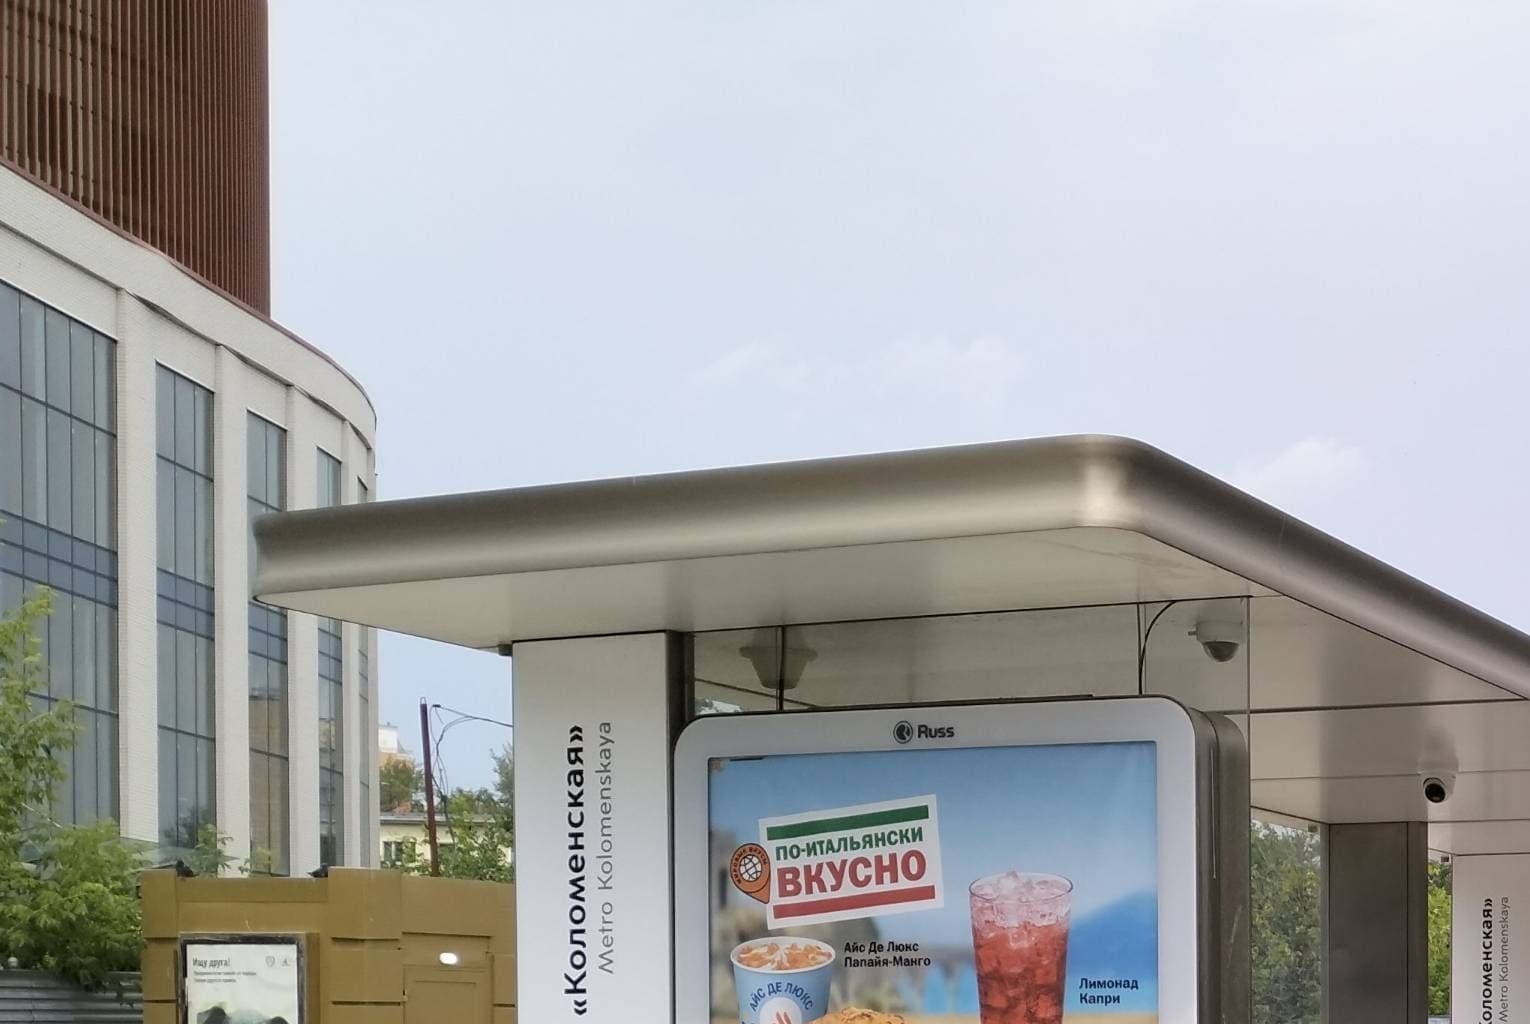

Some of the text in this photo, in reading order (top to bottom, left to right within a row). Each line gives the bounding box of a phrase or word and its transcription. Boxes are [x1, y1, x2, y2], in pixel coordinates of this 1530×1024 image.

[917, 724, 955, 740] Russ
[597, 721, 615, 974] Metro Kolomenskaya
[775, 826, 924, 861] ПО-ИТАЛЬЯНСКИ
[564, 725, 588, 1016] «Коломенская»
[777, 849, 927, 898] ВКУСНО
[844, 941, 919, 955] Айс Де Люкс
[844, 956, 931, 968] Папайя-Манго
[1499, 896, 1510, 1022] Metro Kolomenskaya
[750, 982, 814, 1012] АЙС ДЕ ЛЮКС
[1079, 977, 1139, 991] Лимонад
[1079, 993, 1121, 1006] Капри
